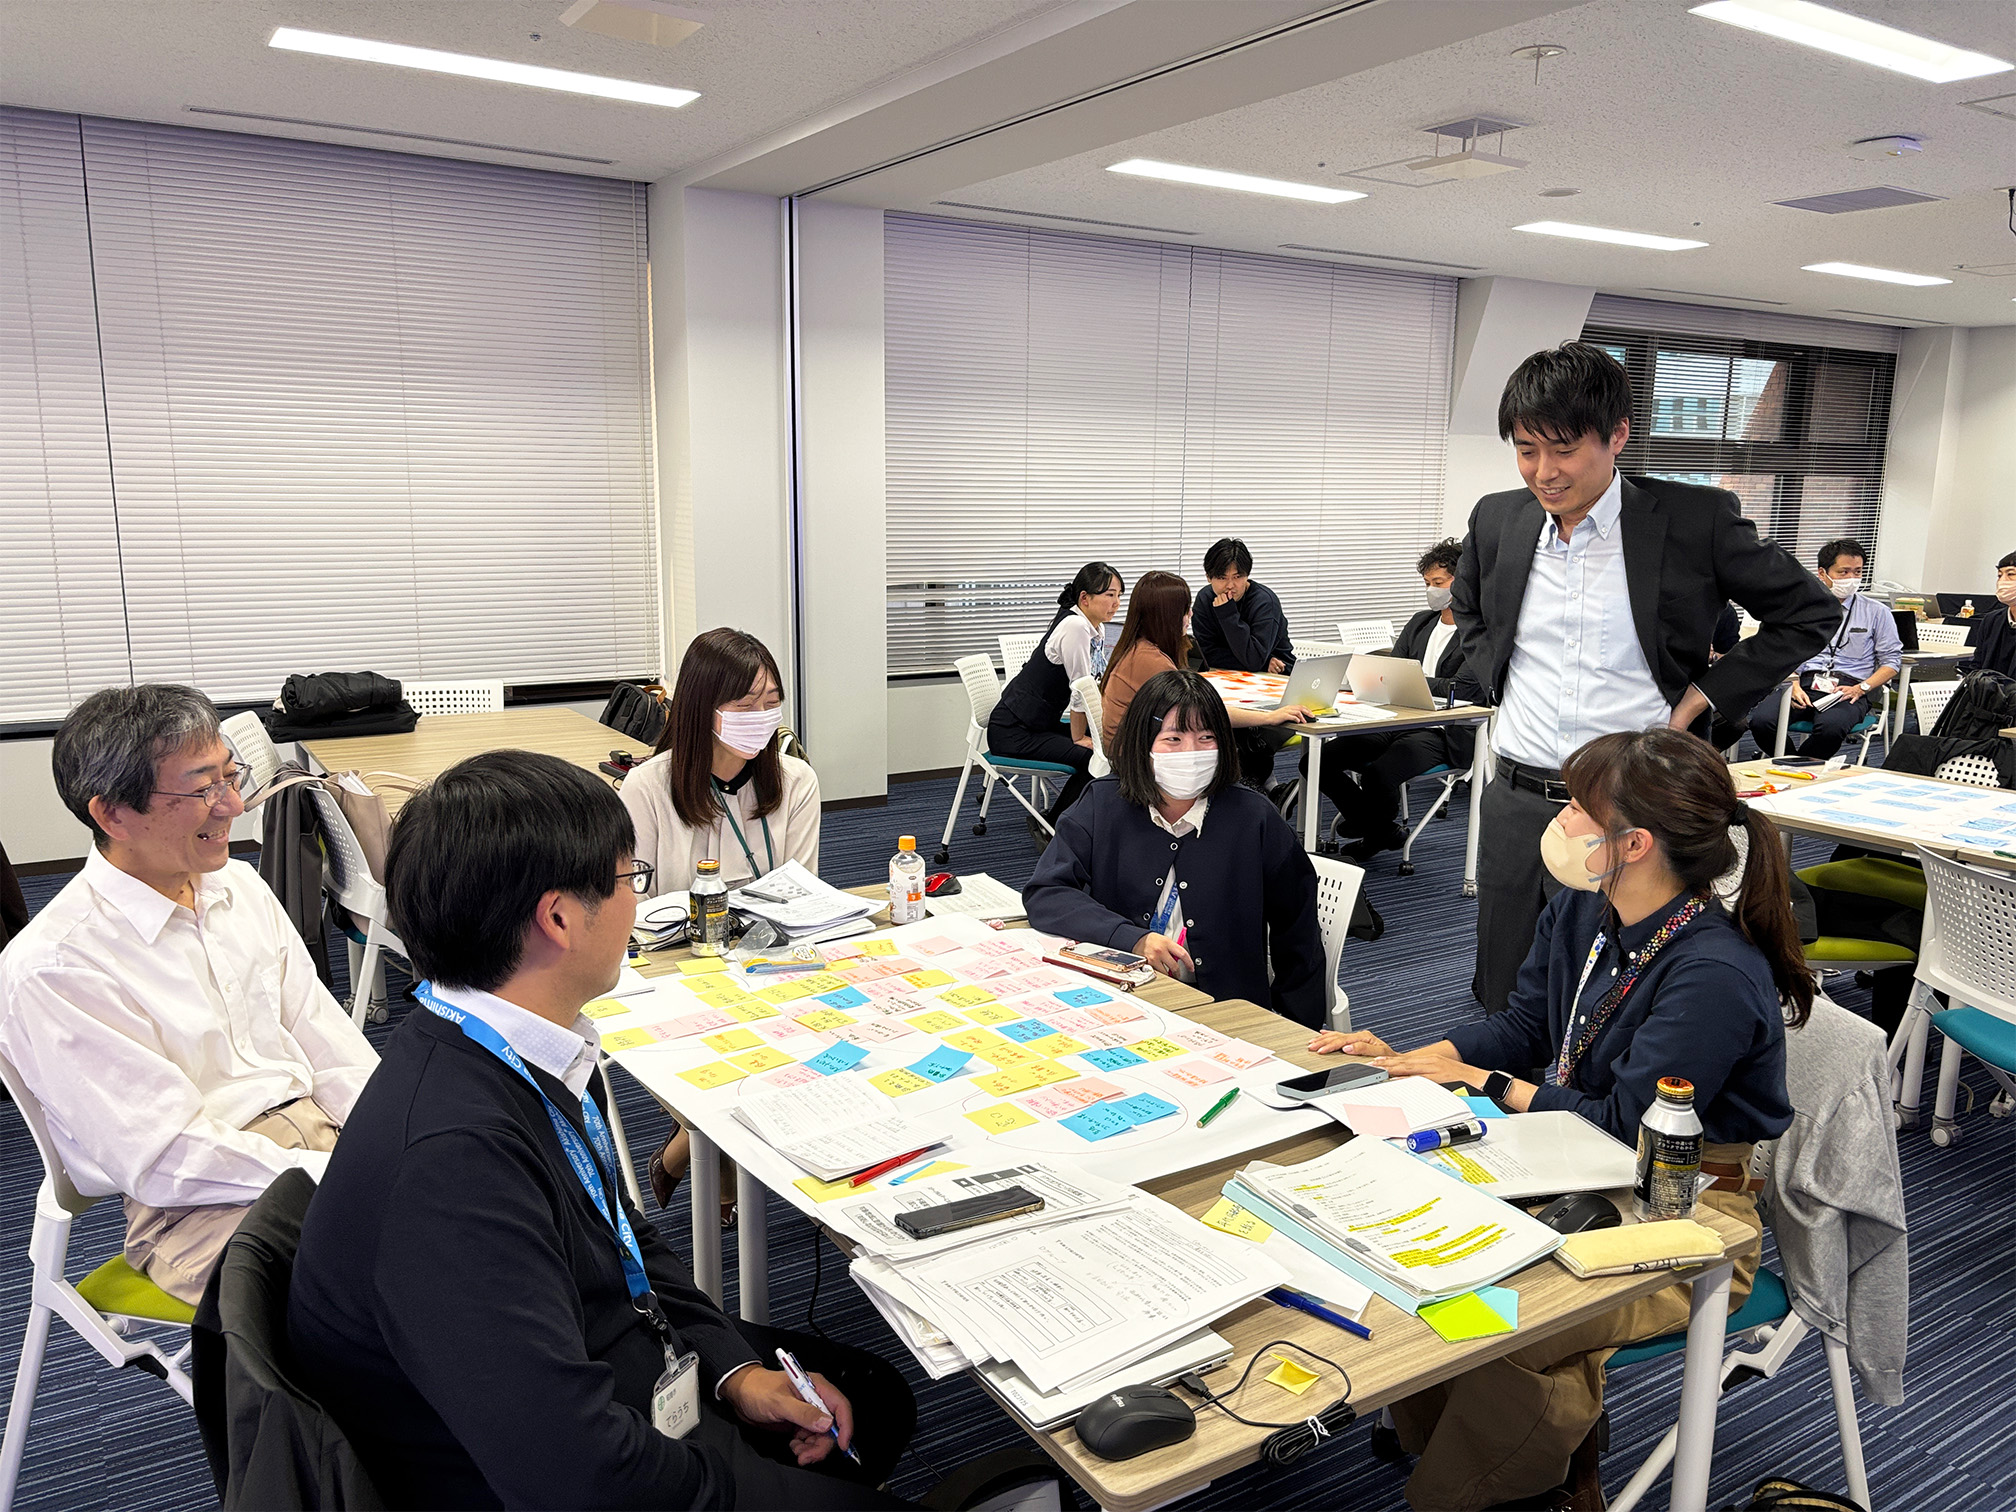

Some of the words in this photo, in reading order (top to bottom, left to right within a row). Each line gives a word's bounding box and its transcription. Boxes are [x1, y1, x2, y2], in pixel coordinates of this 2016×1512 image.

[419, 997, 466, 1024] Akishima
[501, 1045, 522, 1069] City
[621, 1223, 633, 1248] City
[666, 1402, 689, 1427] てらうち
